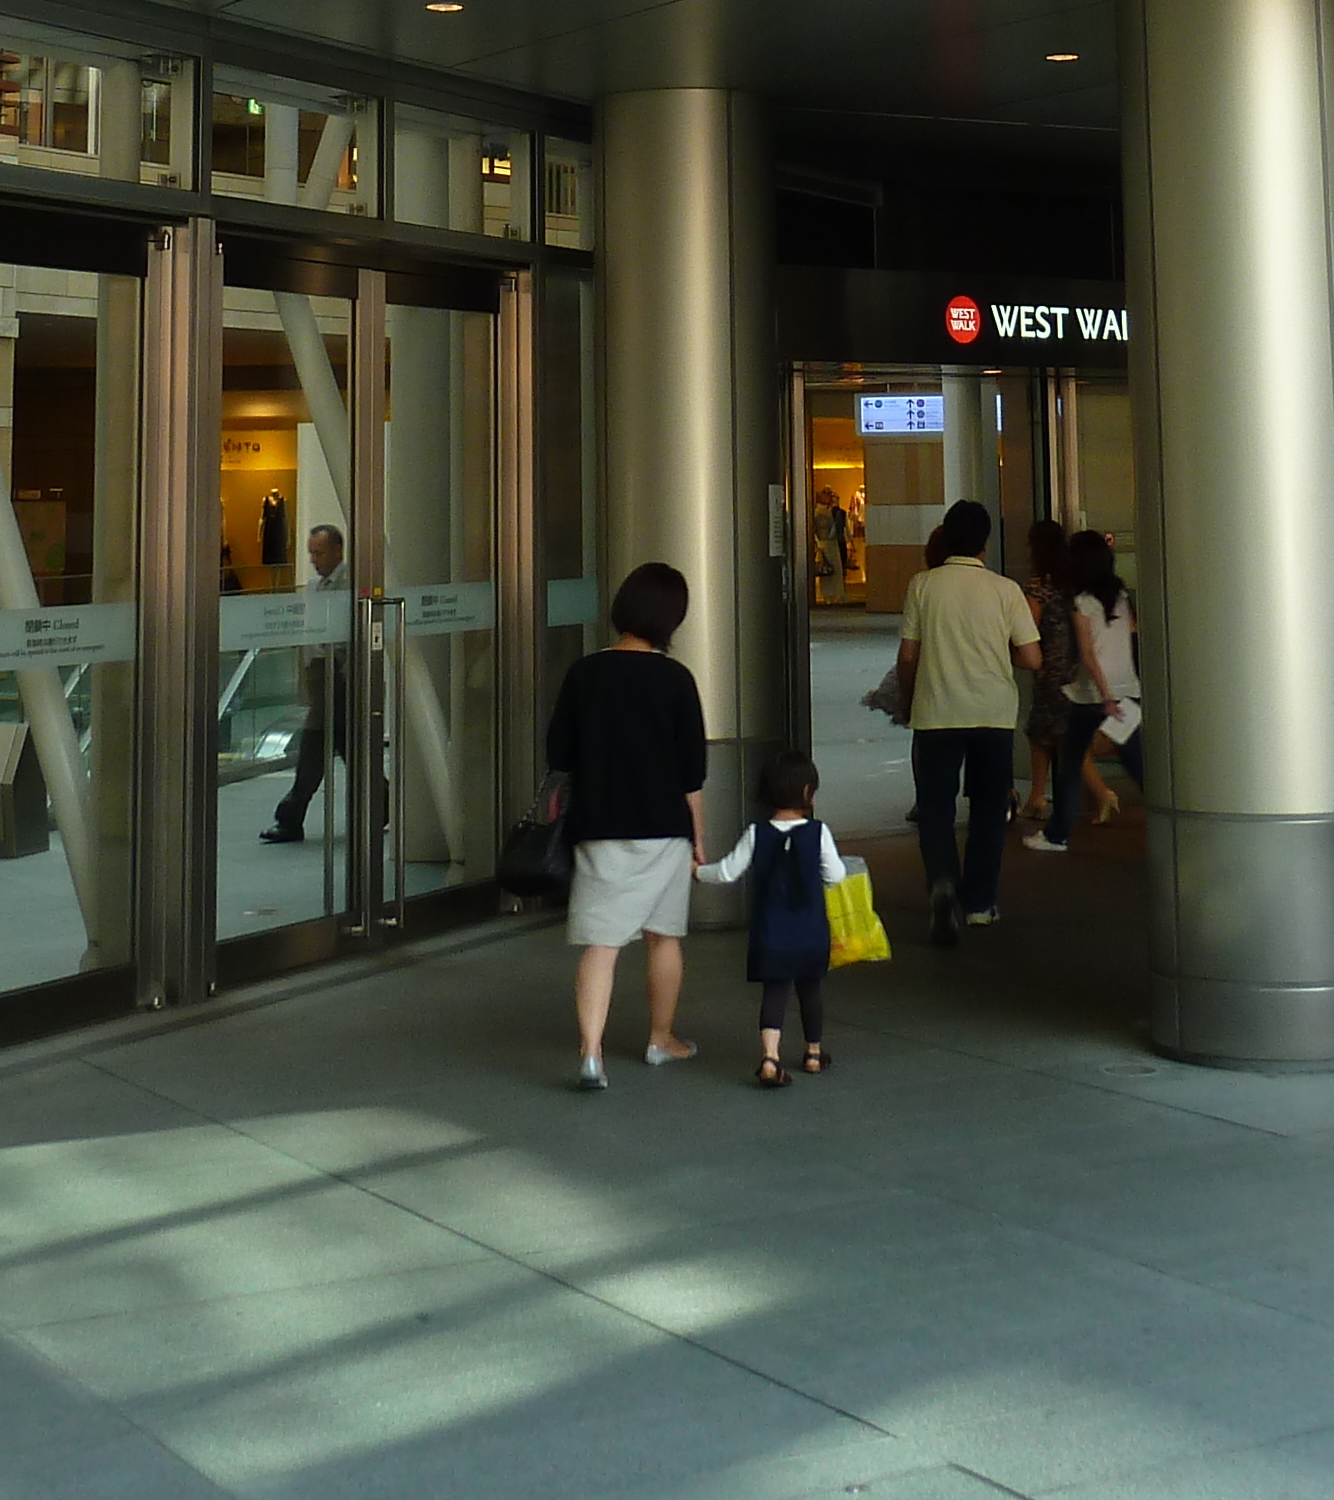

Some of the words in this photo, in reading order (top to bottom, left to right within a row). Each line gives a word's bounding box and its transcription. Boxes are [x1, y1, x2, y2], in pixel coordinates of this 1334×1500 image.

[950, 308, 976, 320] WEST
[950, 320, 977, 331] WALK
[991, 304, 1070, 339] WEST
